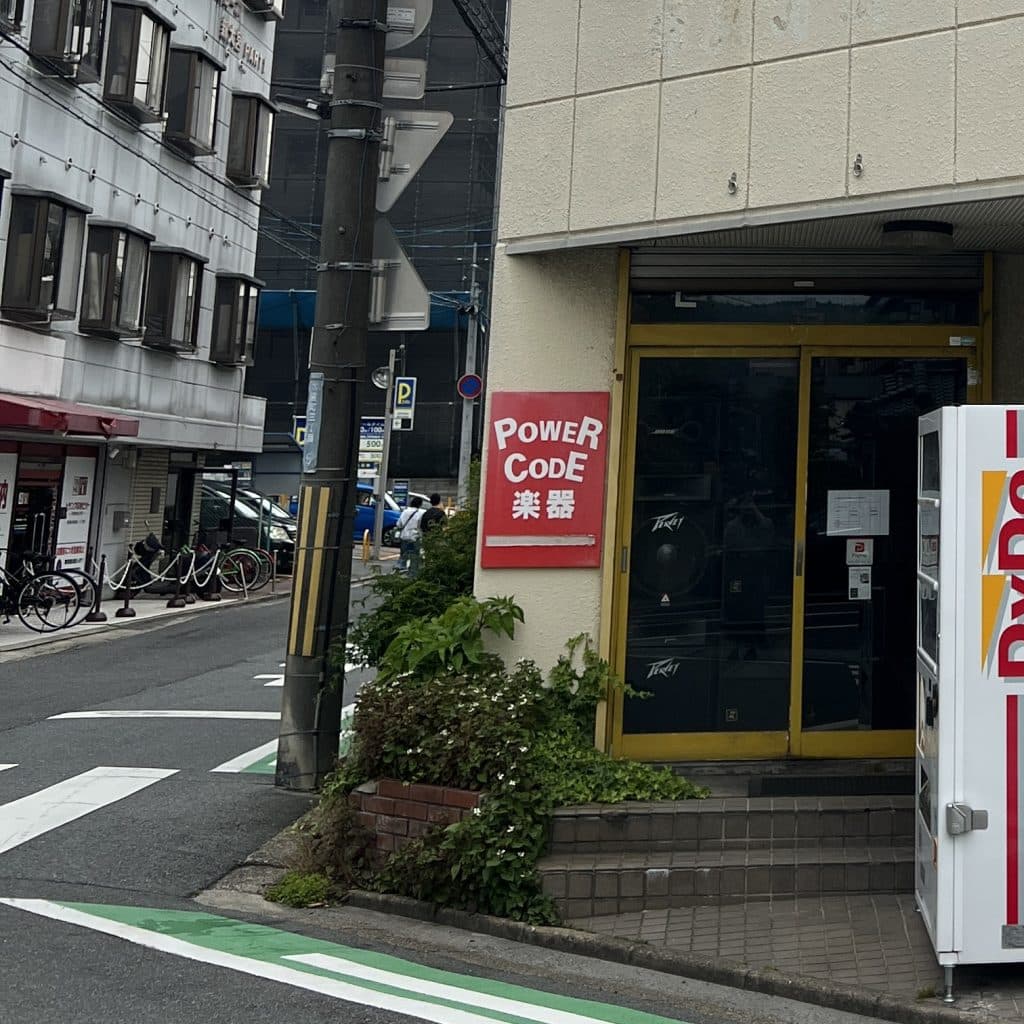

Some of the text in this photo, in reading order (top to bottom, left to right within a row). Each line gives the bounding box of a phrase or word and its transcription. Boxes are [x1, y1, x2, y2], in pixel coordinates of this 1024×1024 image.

[494, 416, 603, 449] POWER
[504, 451, 589, 483] CODE
[511, 489, 576, 521] 楽器
